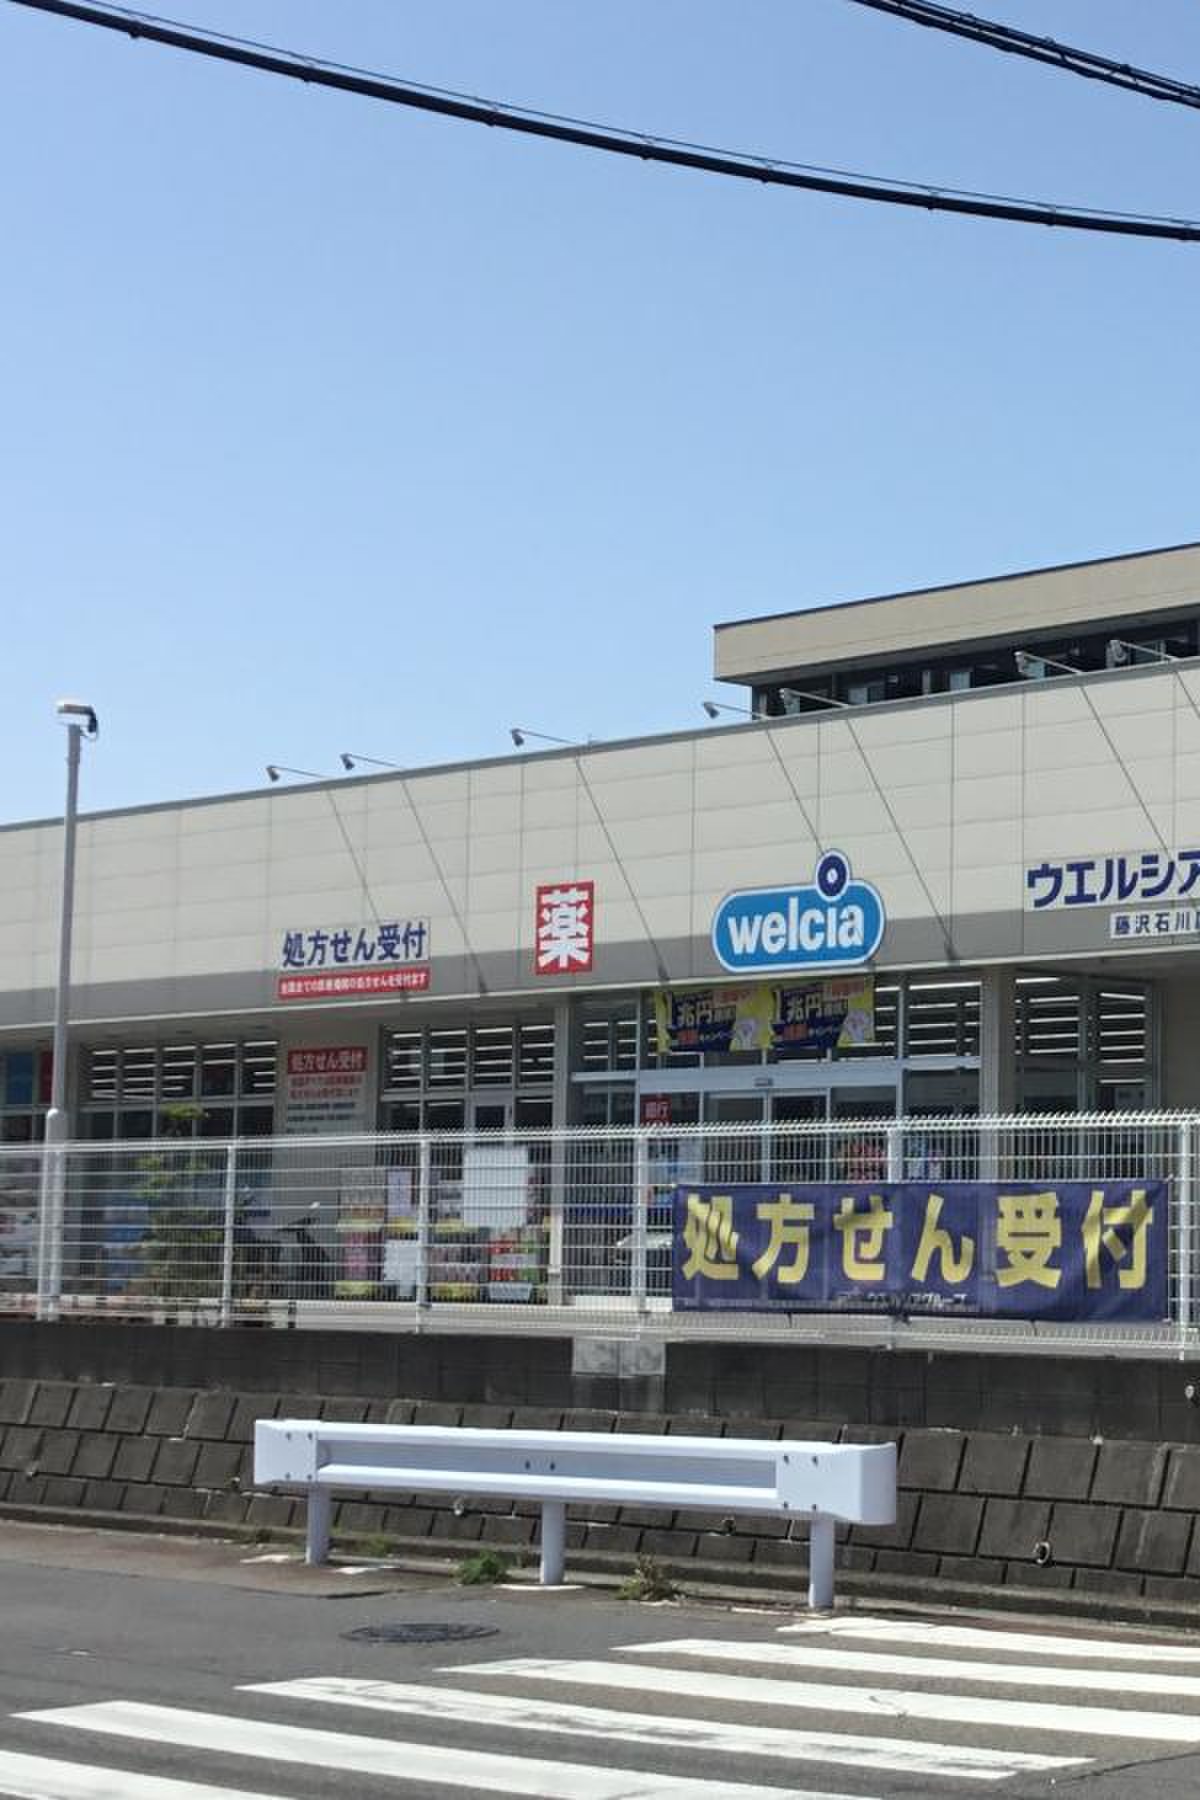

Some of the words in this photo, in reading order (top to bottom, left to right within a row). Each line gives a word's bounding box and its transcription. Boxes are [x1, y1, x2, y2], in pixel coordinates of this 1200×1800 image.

[283, 920, 427, 968] 処方せん受付
[538, 887, 590, 967] 薬
[727, 896, 864, 956] welcia
[682, 1190, 1152, 1289] 処方せん受付
